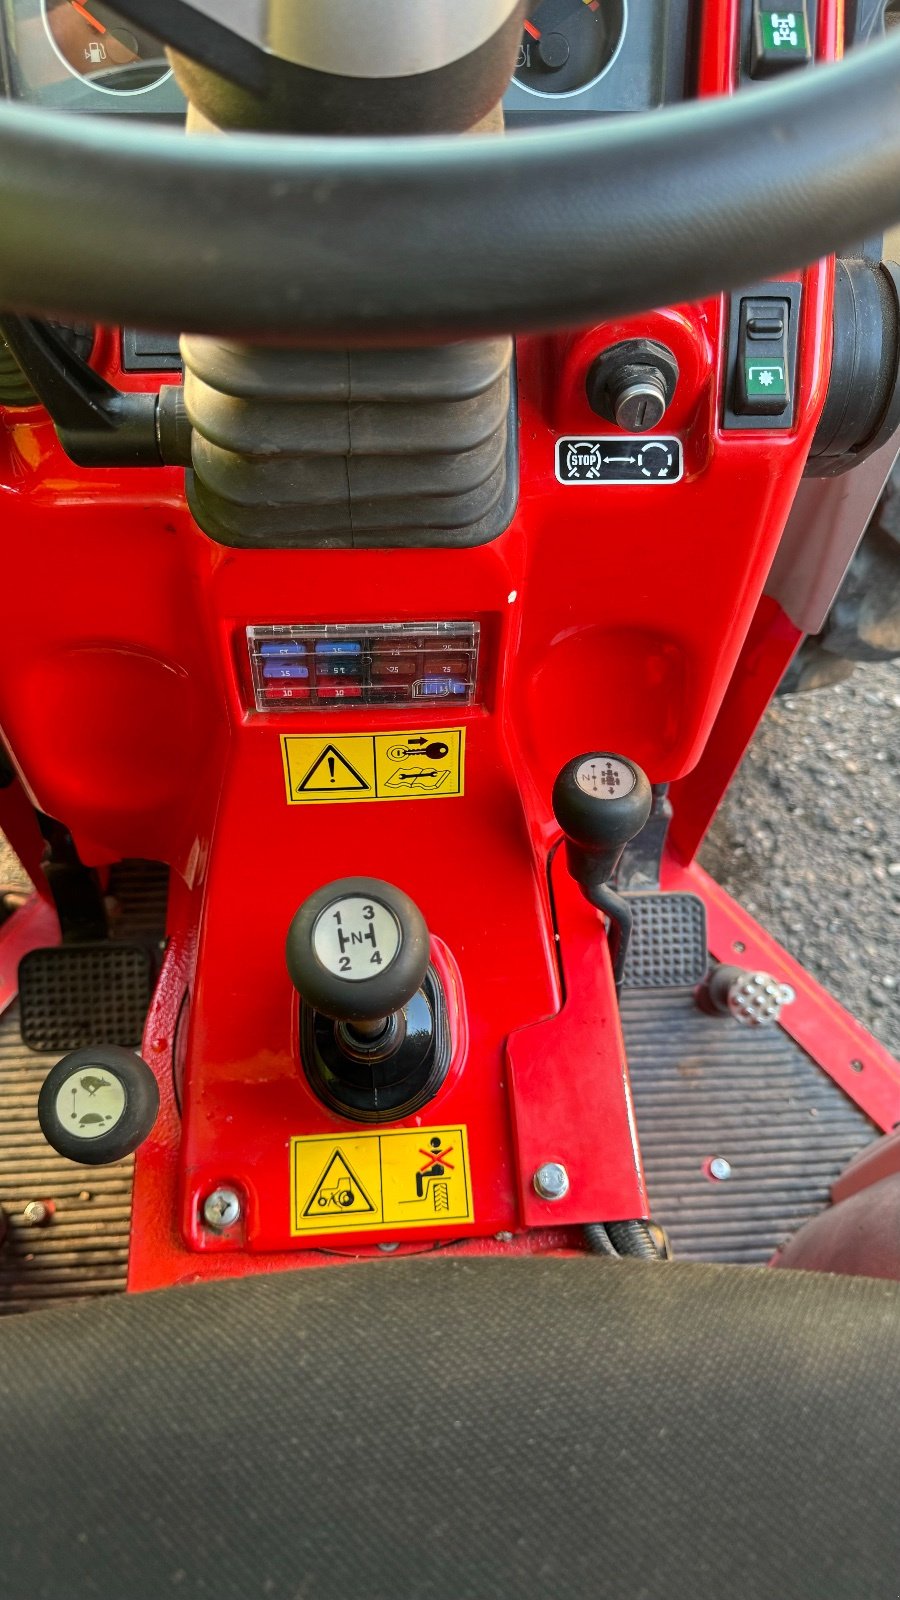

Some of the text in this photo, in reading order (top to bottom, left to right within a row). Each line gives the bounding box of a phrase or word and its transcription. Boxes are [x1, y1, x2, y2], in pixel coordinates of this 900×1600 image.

[572, 455, 596, 466] STOP
[334, 689, 345, 697] 10
[333, 905, 375, 925] 1 3
[351, 931, 363, 944] N
[339, 951, 382, 971] 2 4
